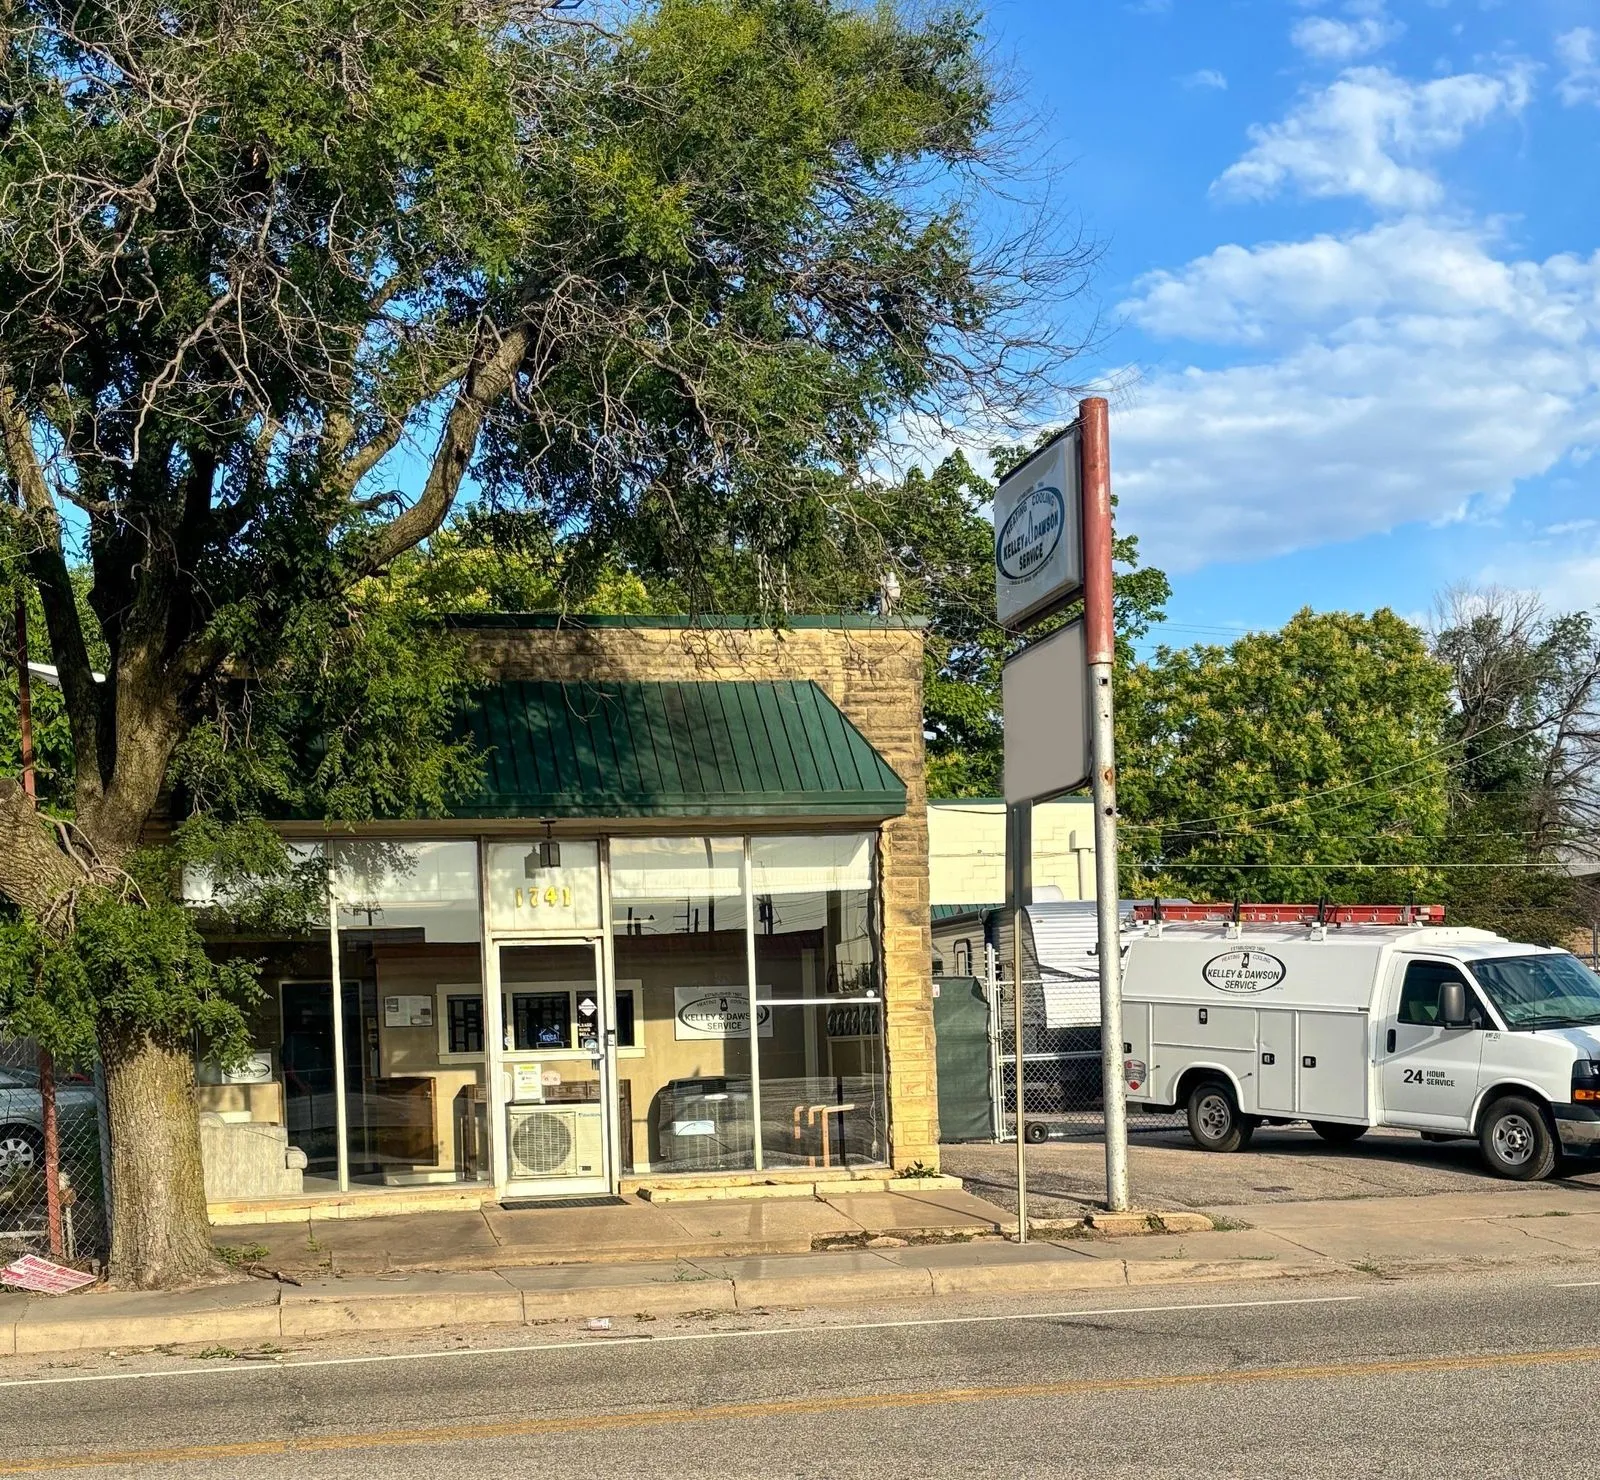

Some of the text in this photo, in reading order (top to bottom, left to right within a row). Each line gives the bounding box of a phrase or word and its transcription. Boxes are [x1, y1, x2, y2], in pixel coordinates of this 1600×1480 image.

[1006, 501, 1028, 537] HEATING
[1031, 492, 1055, 506] COOLING
[1003, 534, 1025, 561] KELLEY
[1034, 509, 1059, 541] DAWSON
[1019, 542, 1043, 571] SERVICE
[515, 885, 571, 908] 1741
[1221, 954, 1271, 964] HEATING COOLING
[1207, 969, 1280, 980] KELLEY & DAWSON
[1224, 980, 1258, 990] SERVICE
[696, 999, 717, 1007] HEATING
[684, 1012, 764, 1022] KELLEY & DAWSN
[707, 1021, 742, 1030] SERVICE
[1403, 1069, 1446, 1084] 24 HOUR
[1426, 1078, 1456, 1087] SERVICE
